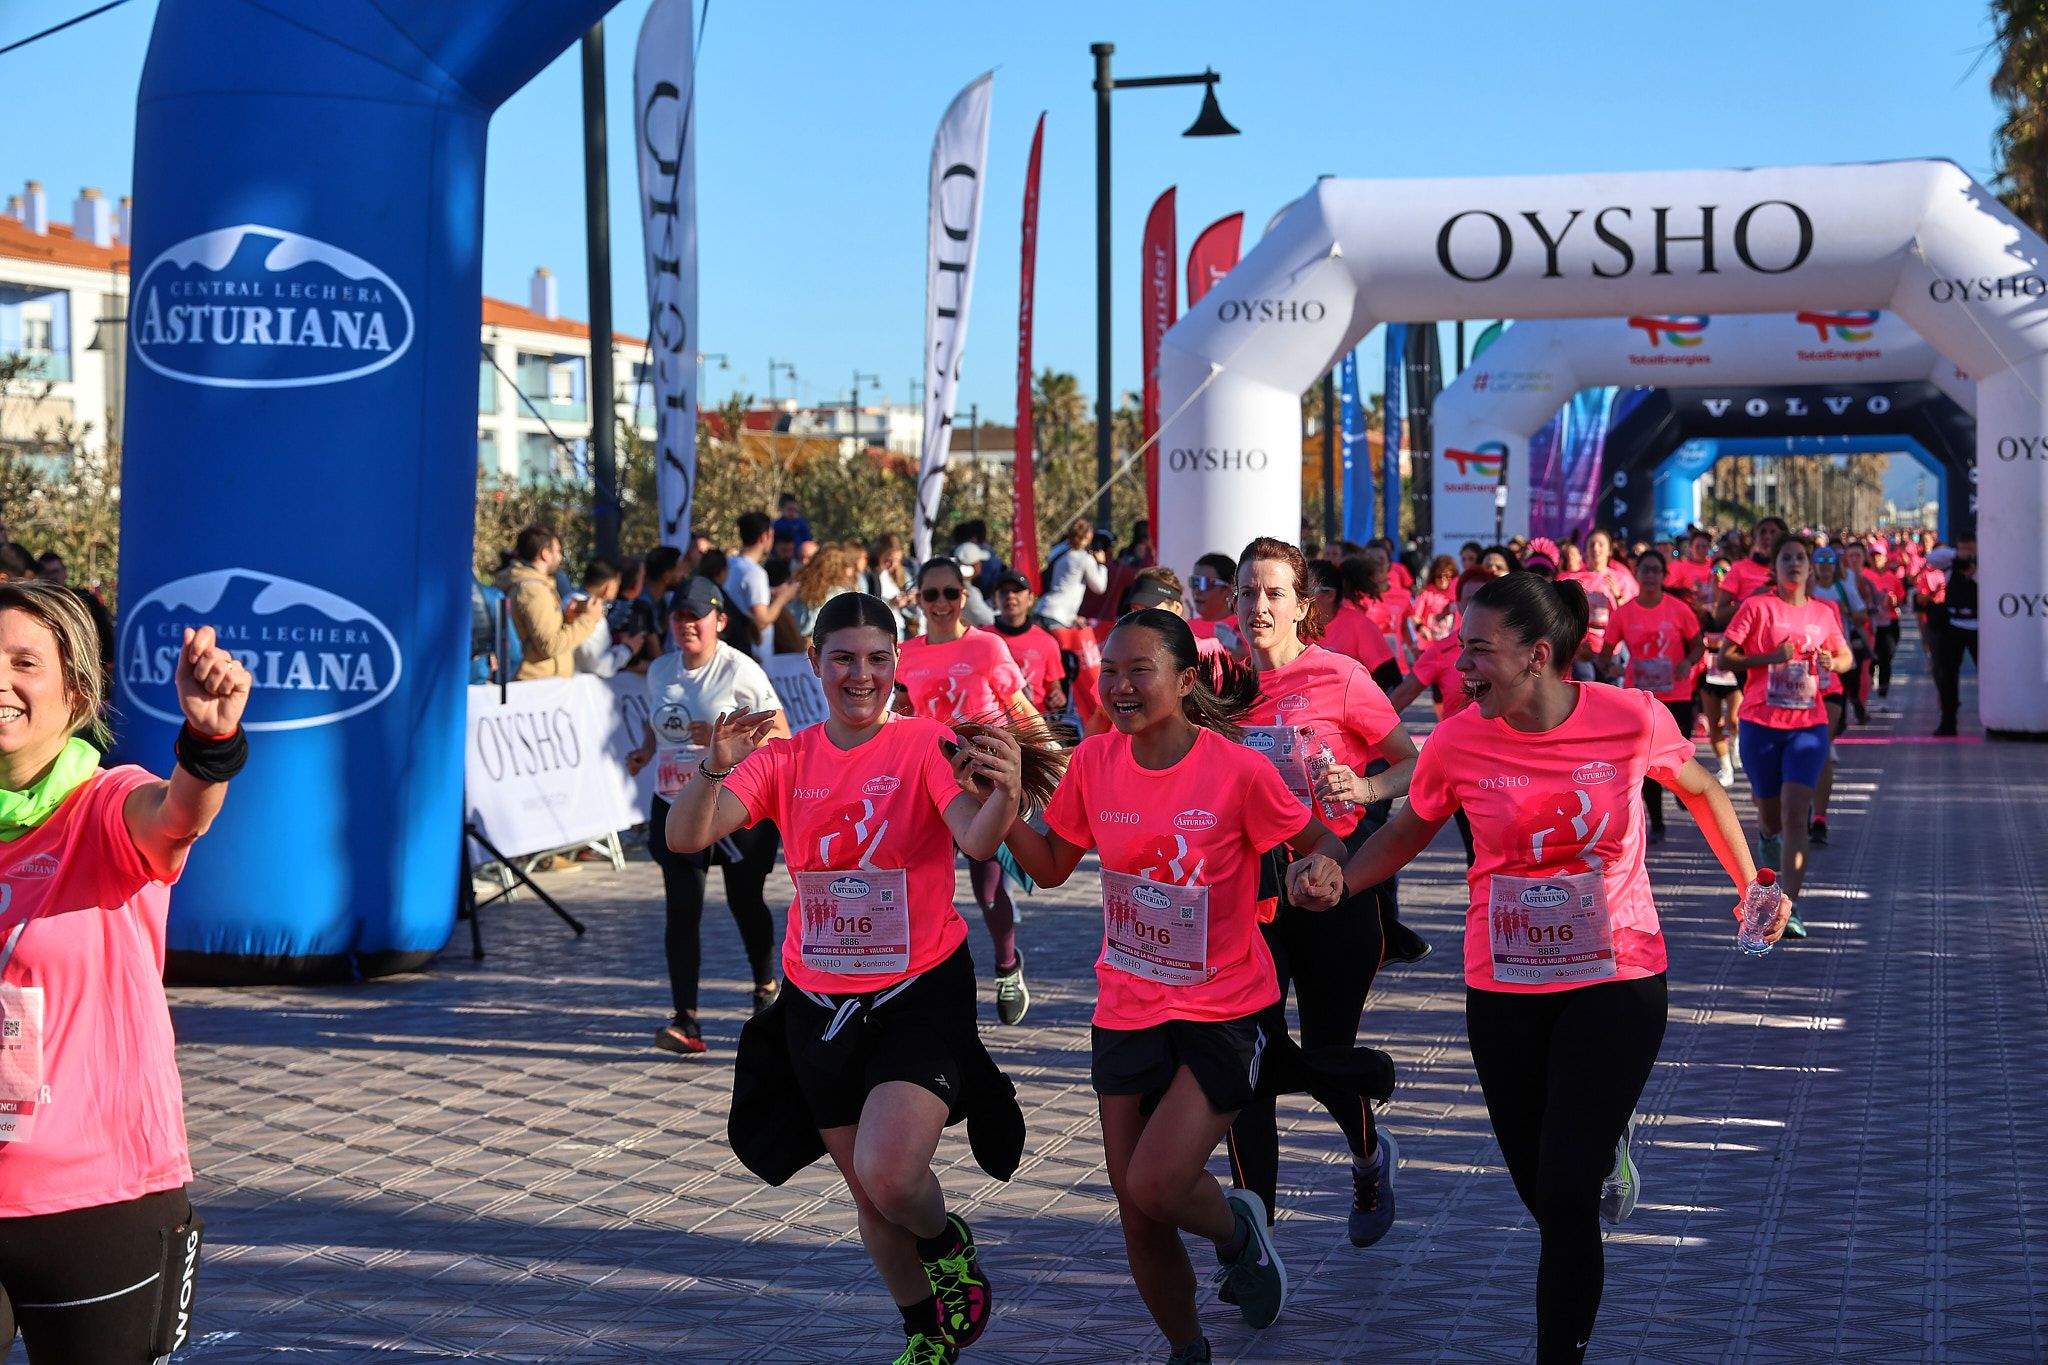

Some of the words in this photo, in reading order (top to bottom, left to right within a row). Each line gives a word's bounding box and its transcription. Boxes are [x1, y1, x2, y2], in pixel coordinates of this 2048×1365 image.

[1436, 200, 1814, 283] OYSHO
[170, 280, 262, 297] CENTRAL
[275, 282, 383, 304] LECHERA
[1929, 275, 2046, 303] OYSHO
[140, 286, 392, 351] ASTURIANA
[1217, 300, 1325, 323] OYSHO
[1702, 395, 1892, 418] VOLVO
[1169, 448, 1268, 473] OYSHO
[157, 622, 250, 640] CERAL
[262, 626, 371, 644] LECHERA
[129, 625, 379, 692] ASRIANA
[477, 708, 581, 781] OYSHO
[1478, 775, 1530, 789] OYSHO
[1100, 810, 1140, 825] OYSHO
[1177, 817, 1213, 826] ASTURIANA
[832, 885, 867, 894] ASTURIANA
[1134, 889, 1168, 907] ASTURIANA
[1524, 894, 1566, 903] ASTURIANA
[834, 916, 873, 934] 016
[1134, 920, 1171, 945] 016
[1528, 924, 1574, 943] 016
[1115, 943, 1134, 955] CARRERA
[1166, 959, 1191, 968] VALENCIA
[1506, 956, 1530, 964] CARRERA
[1571, 953, 1598, 962] VALENCIA
[1538, 947, 1560, 956] 8889
[811, 959, 841, 968] OYSHO
[862, 960, 897, 968] Santander
[1114, 954, 1141, 970] OYSHO
[1159, 970, 1192, 981] Santander
[1506, 968, 1541, 978] OYSHO
[1564, 966, 1602, 977] Santander
